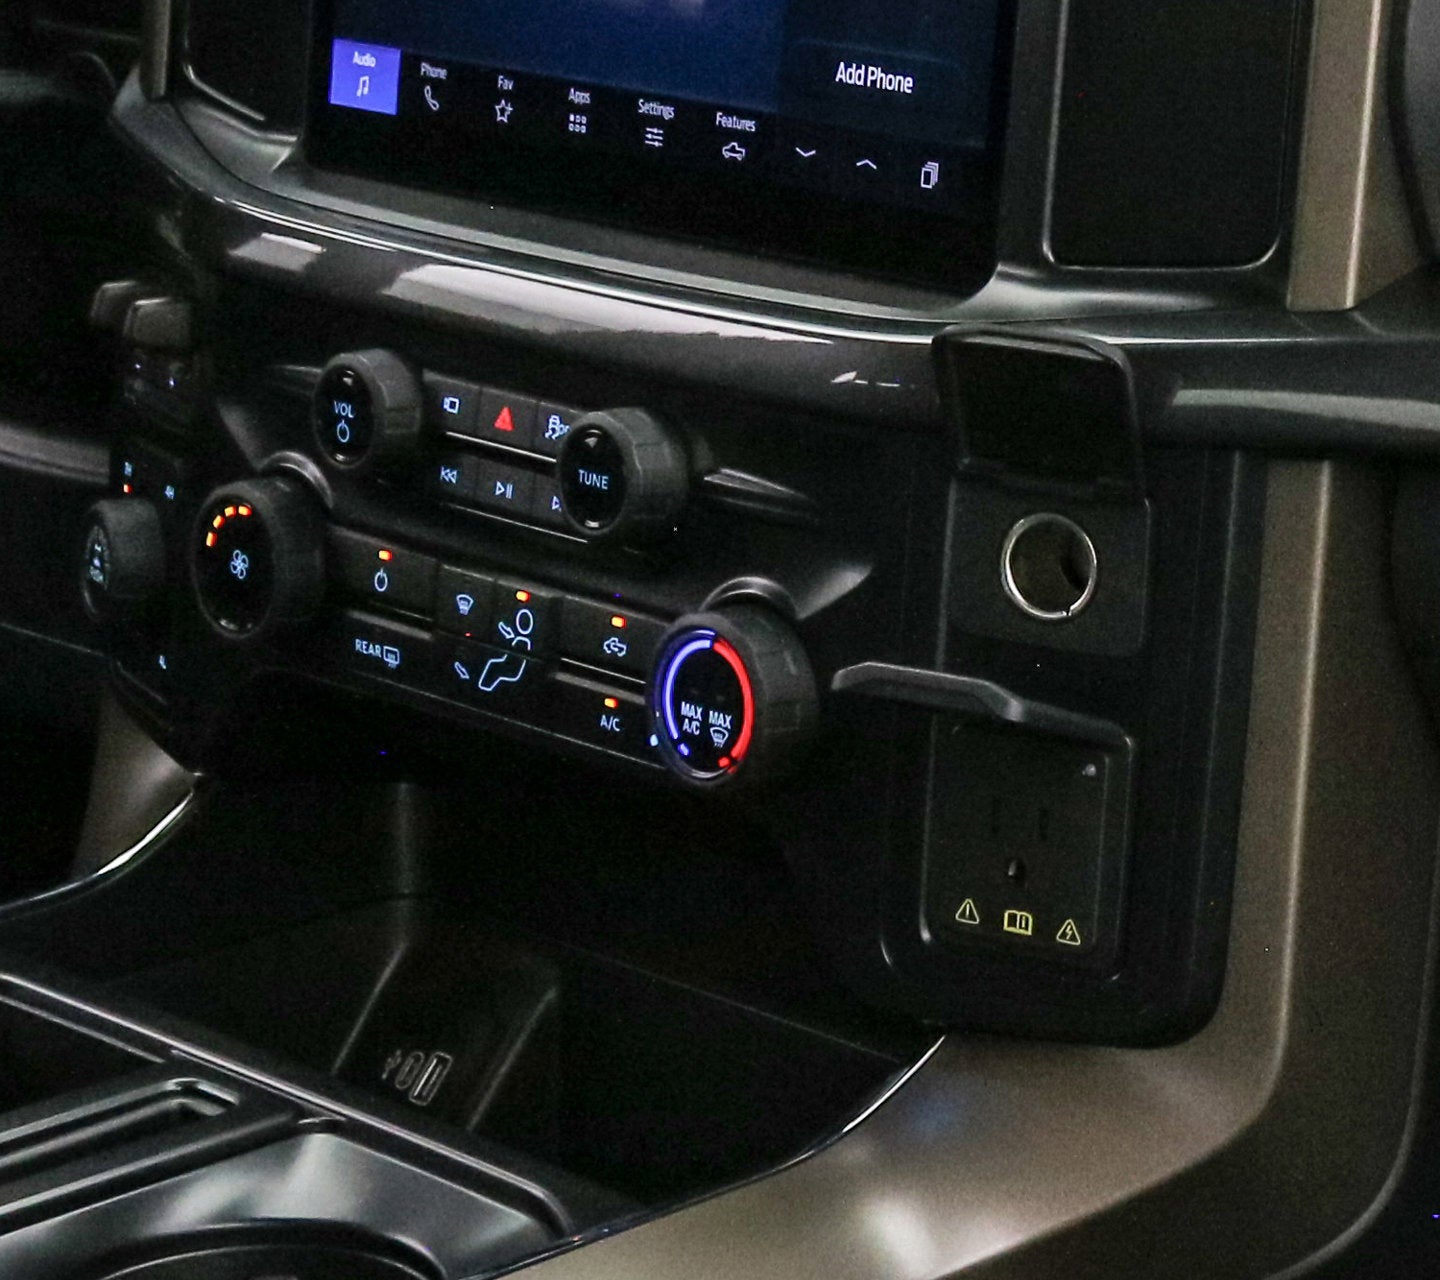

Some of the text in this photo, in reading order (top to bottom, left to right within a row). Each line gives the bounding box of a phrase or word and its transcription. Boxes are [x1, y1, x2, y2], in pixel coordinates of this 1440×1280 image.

[352, 51, 377, 69] Audio
[420, 61, 448, 80] Phone
[835, 61, 914, 94] Add Phone
[497, 74, 514, 90] Fav
[568, 87, 591, 105] Apps
[637, 98, 675, 121] Settings
[715, 111, 756, 132] Features
[334, 400, 355, 419] VOL
[578, 469, 609, 490] TUNE
[355, 638, 382, 658] REAR
[680, 701, 703, 719] MAX
[708, 710, 732, 729] MAX
[600, 714, 621, 732] A/C
[681, 717, 702, 736] A/C
